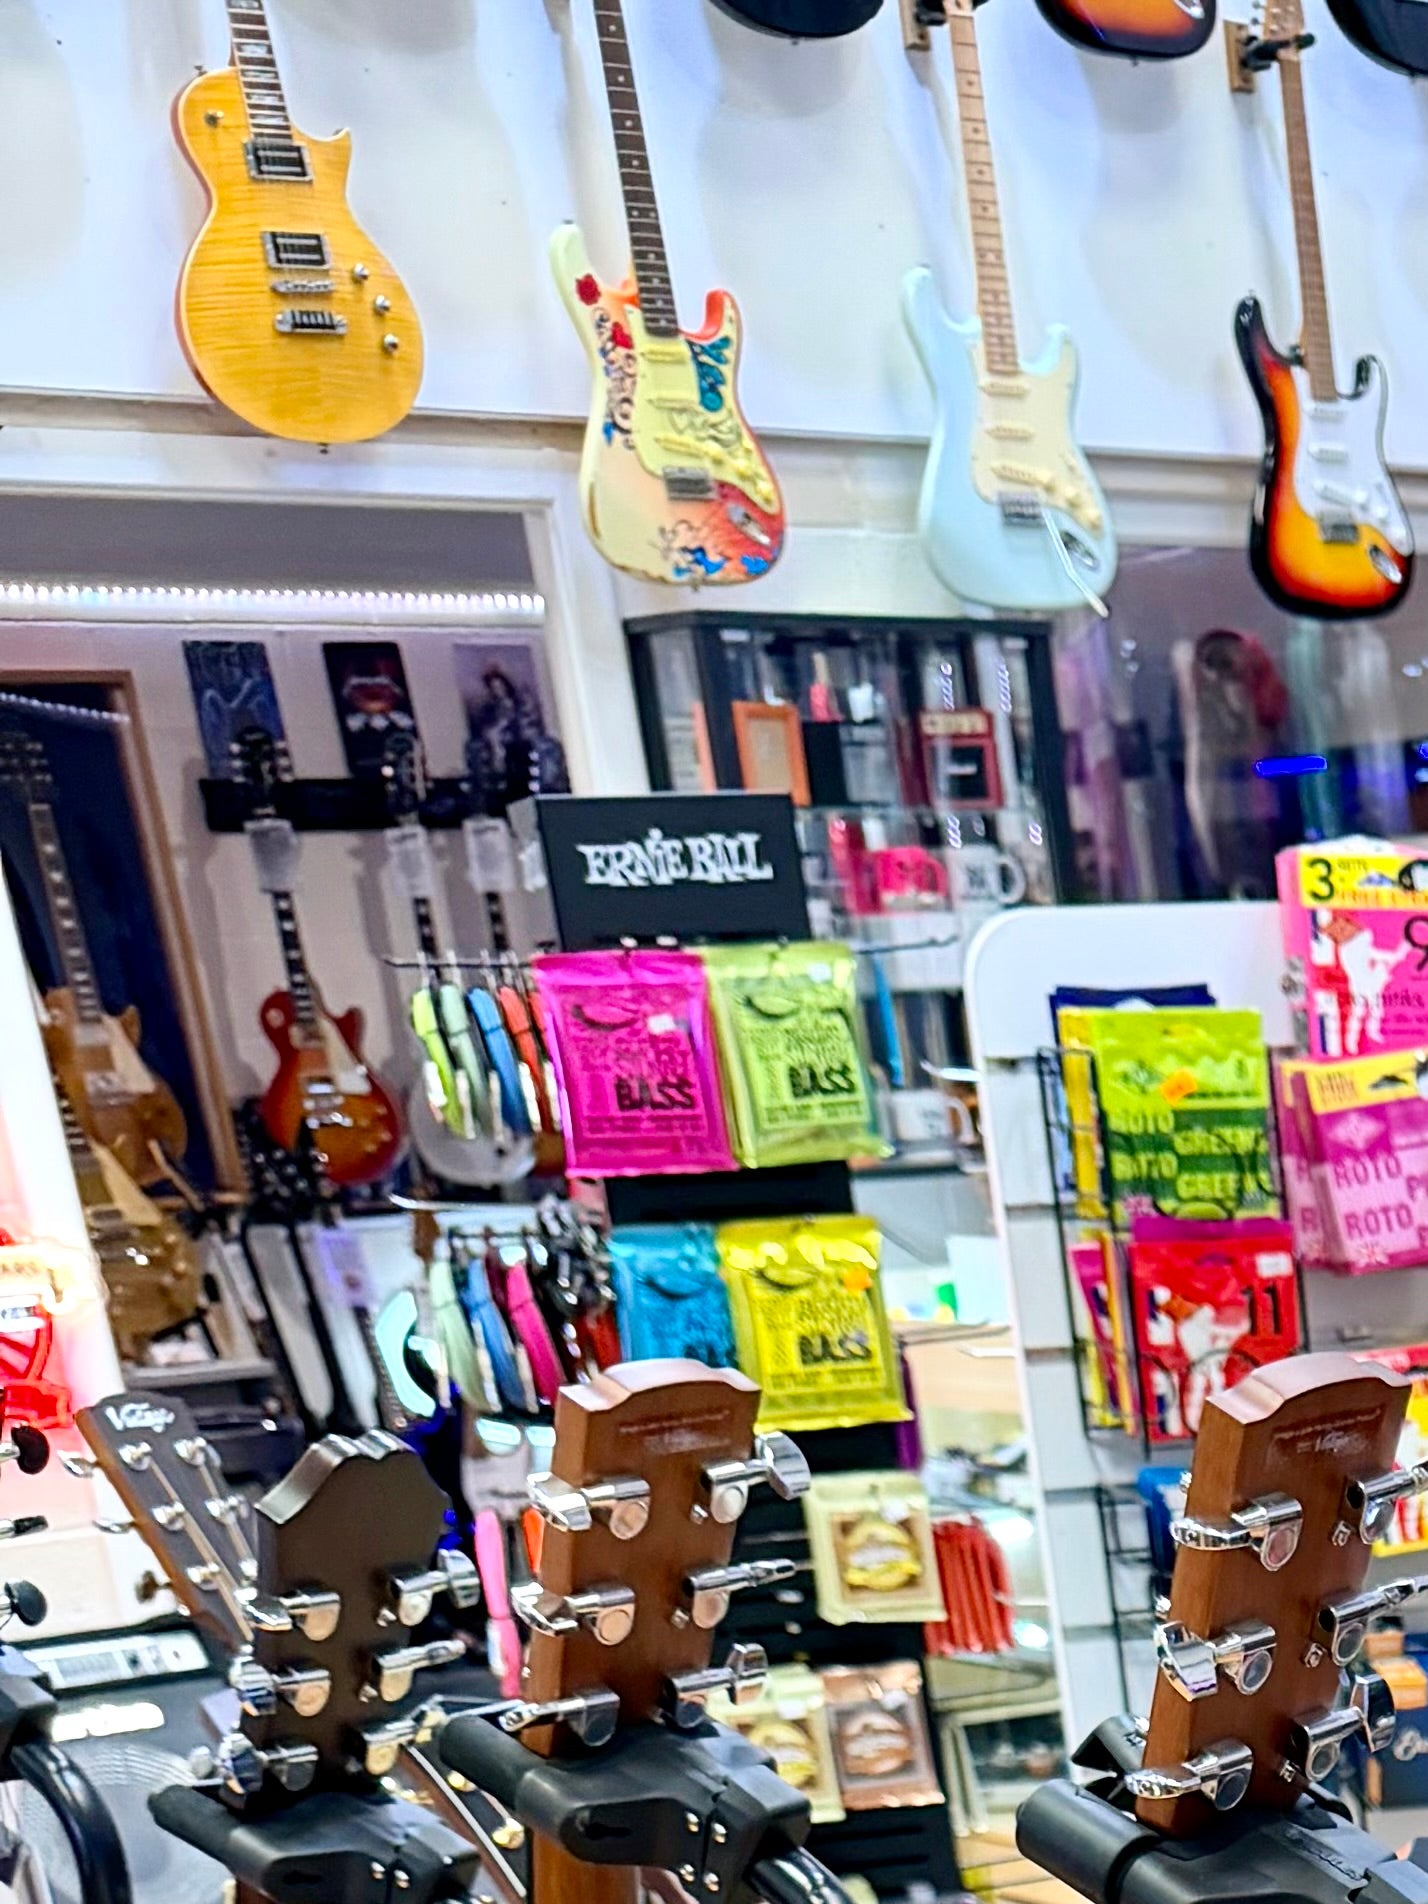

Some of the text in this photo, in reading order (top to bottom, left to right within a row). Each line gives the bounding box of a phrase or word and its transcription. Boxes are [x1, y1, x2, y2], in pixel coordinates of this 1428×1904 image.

[576, 827, 774, 887] ERNIE BALL
[1307, 857, 1335, 901] 3
[614, 1076, 694, 1111] BASS
[788, 1063, 857, 1099] BASS
[1333, 1155, 1401, 1188] ROTO
[1344, 1202, 1413, 1240] ROTO
[1242, 1284, 1283, 1337] 11
[798, 1334, 872, 1366] BASS
